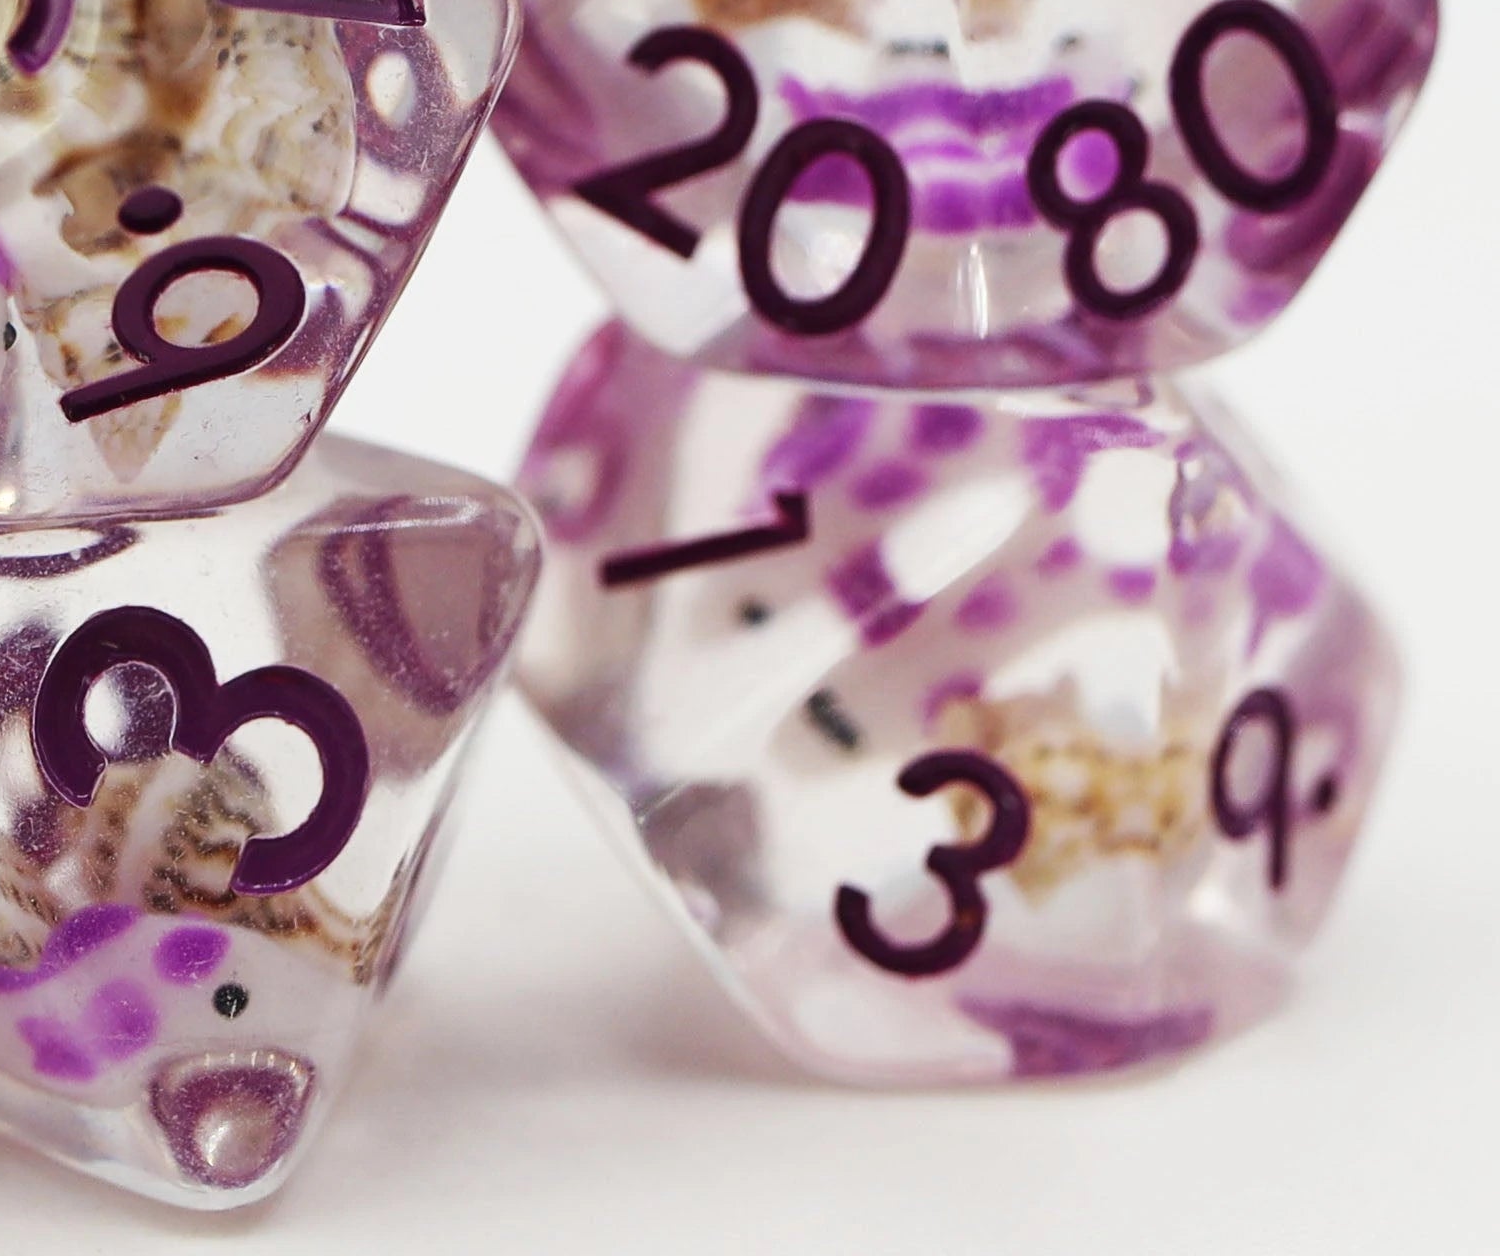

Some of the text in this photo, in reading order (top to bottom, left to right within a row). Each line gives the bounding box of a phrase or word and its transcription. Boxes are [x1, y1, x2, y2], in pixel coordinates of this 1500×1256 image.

[575, 22, 912, 338] 20
[600, 490, 809, 590] 1
[33, 606, 368, 896] 3
[834, 749, 1032, 979] 3
